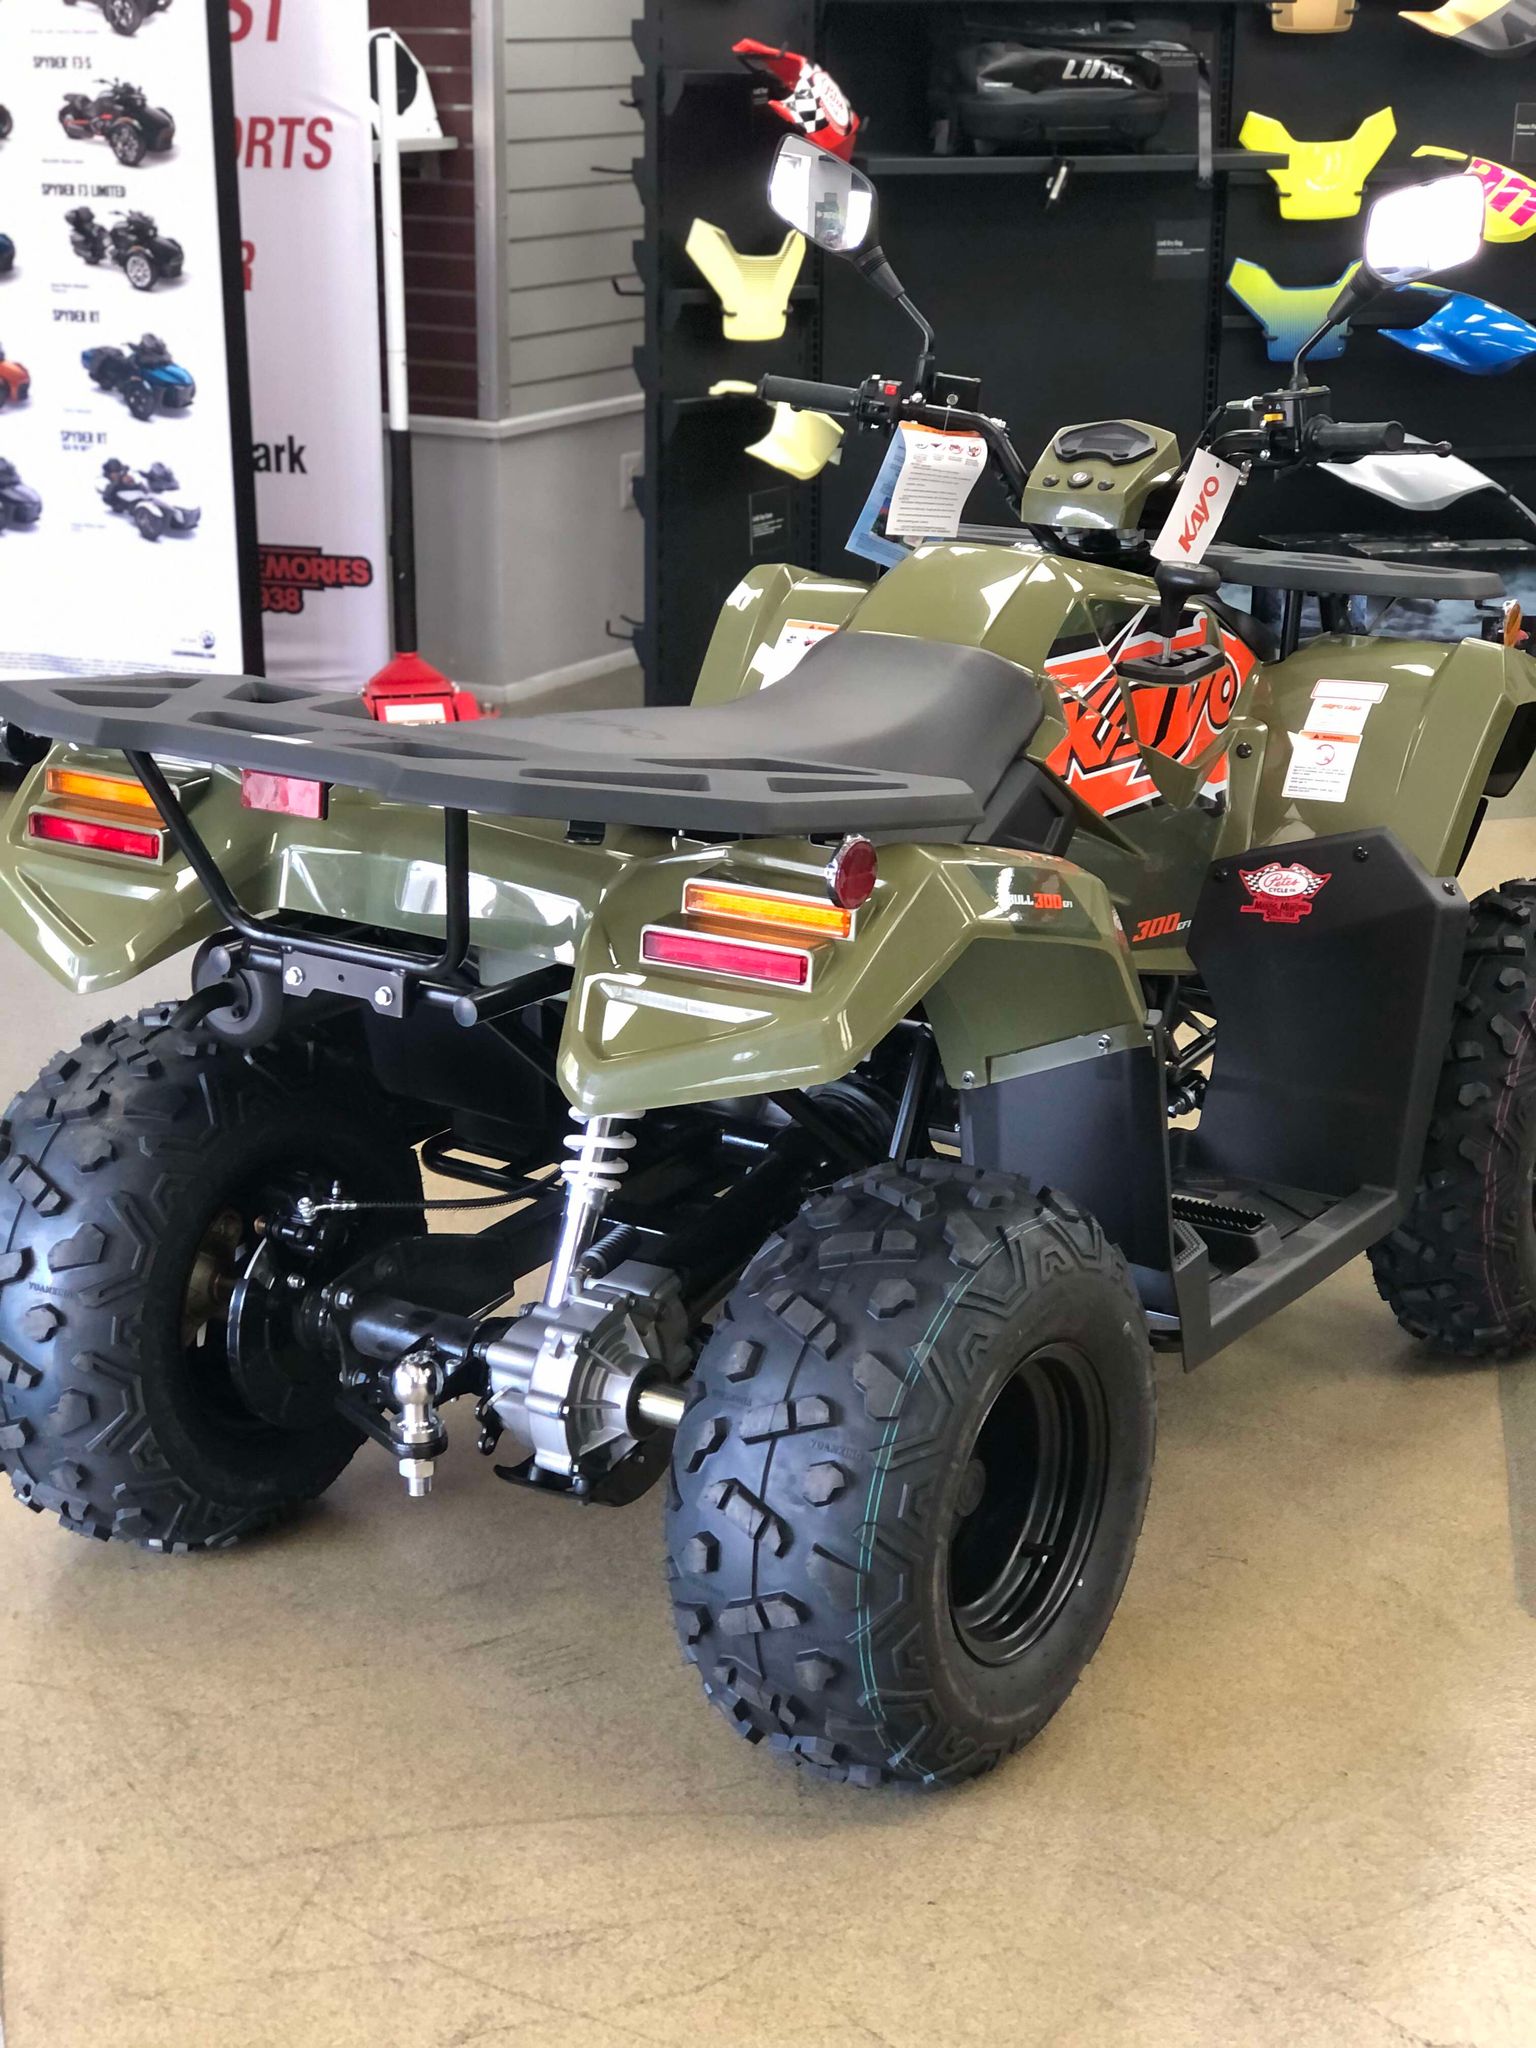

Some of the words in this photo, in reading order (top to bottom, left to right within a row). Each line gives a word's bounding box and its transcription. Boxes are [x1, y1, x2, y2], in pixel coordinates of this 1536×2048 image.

[235, 116, 333, 171] RTS
[41, 183, 75, 196] SPYDER
[91, 184, 126, 198] LIMITED
[1178, 476, 1220, 553] KAYO
